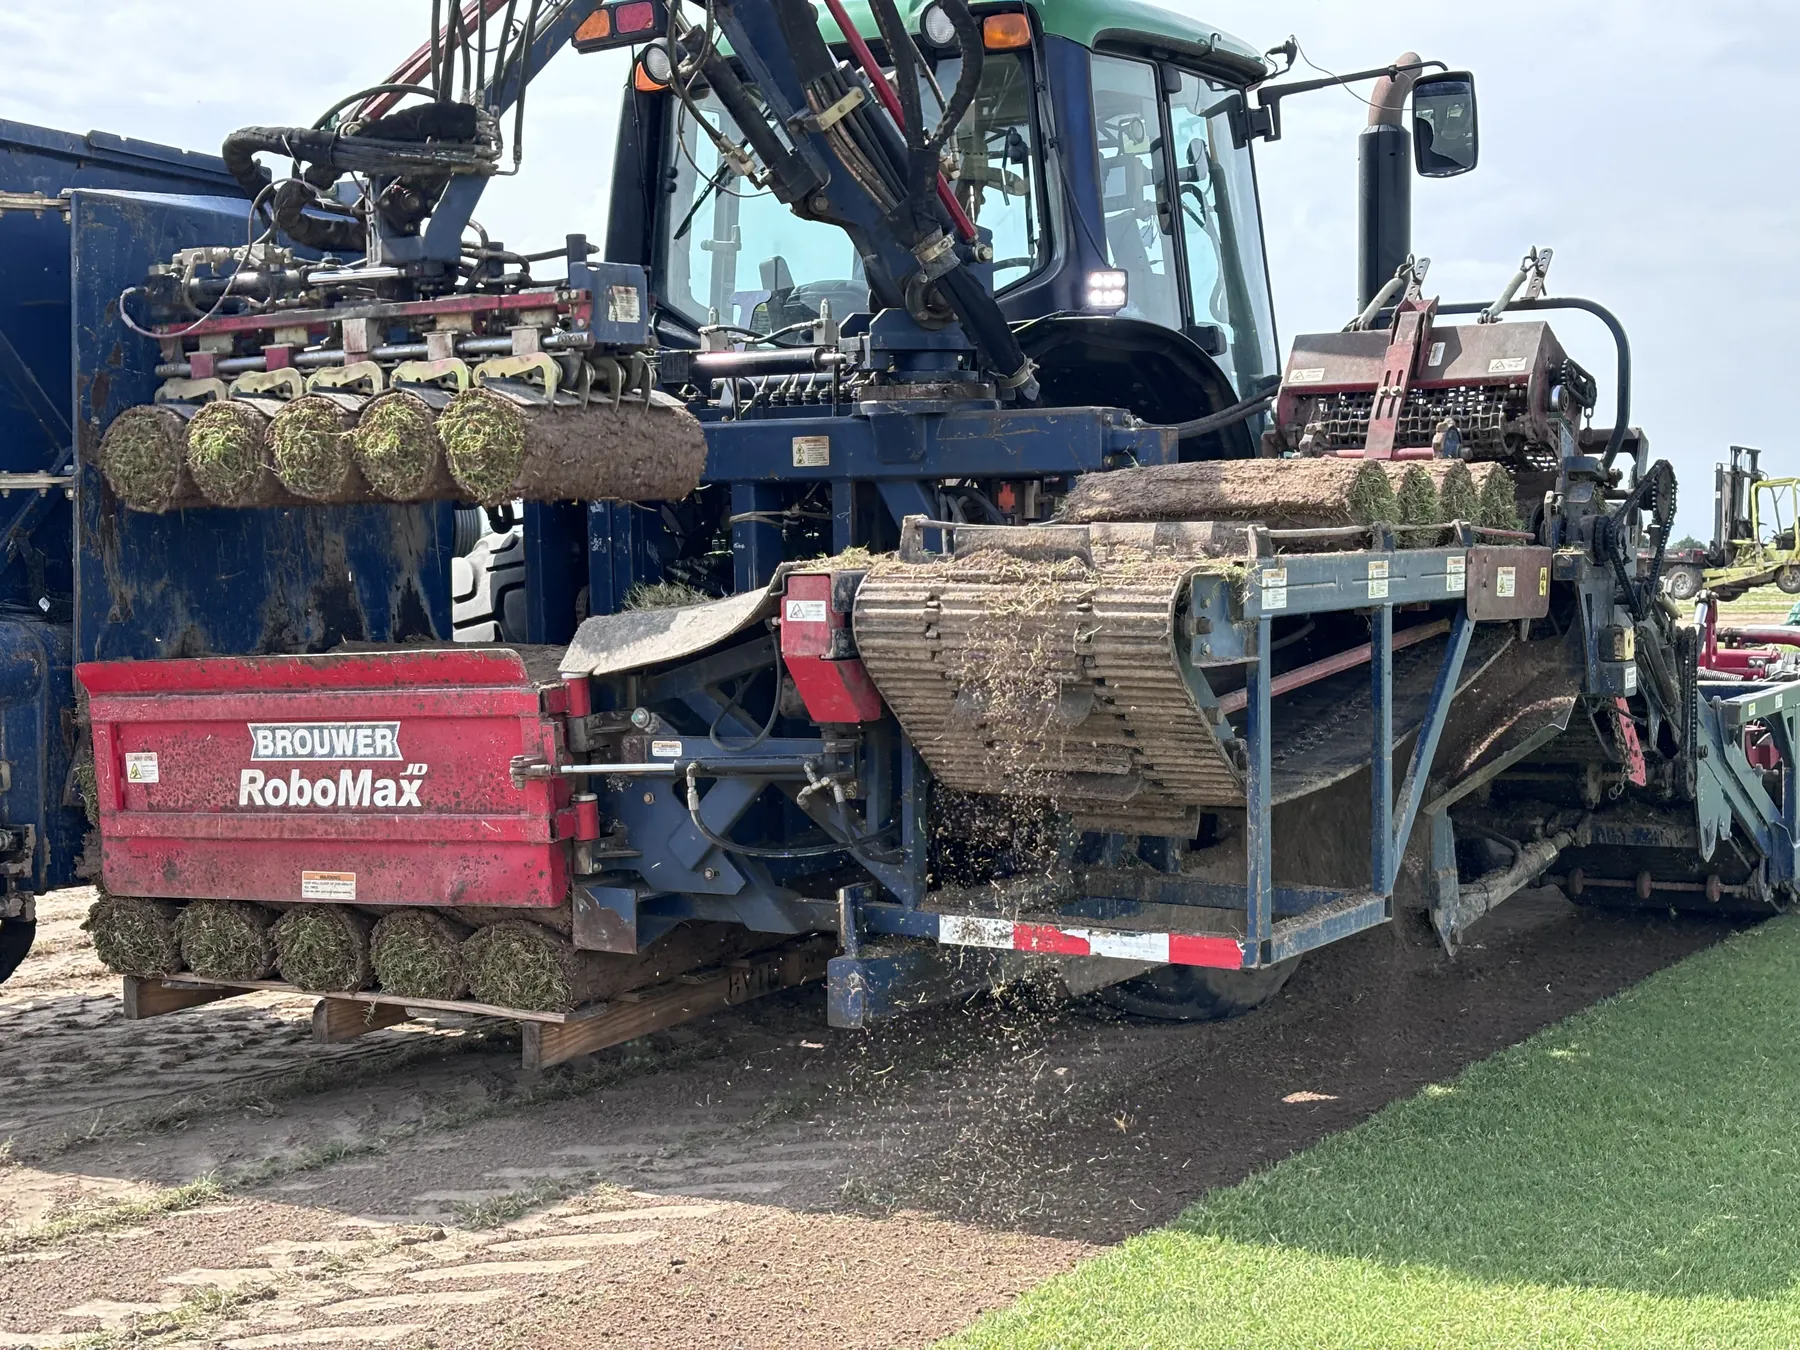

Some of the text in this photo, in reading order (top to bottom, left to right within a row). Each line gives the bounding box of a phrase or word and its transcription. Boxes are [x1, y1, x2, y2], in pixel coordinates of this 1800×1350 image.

[256, 728, 395, 756] BROUWER
[239, 763, 428, 806] RoboMax JD
